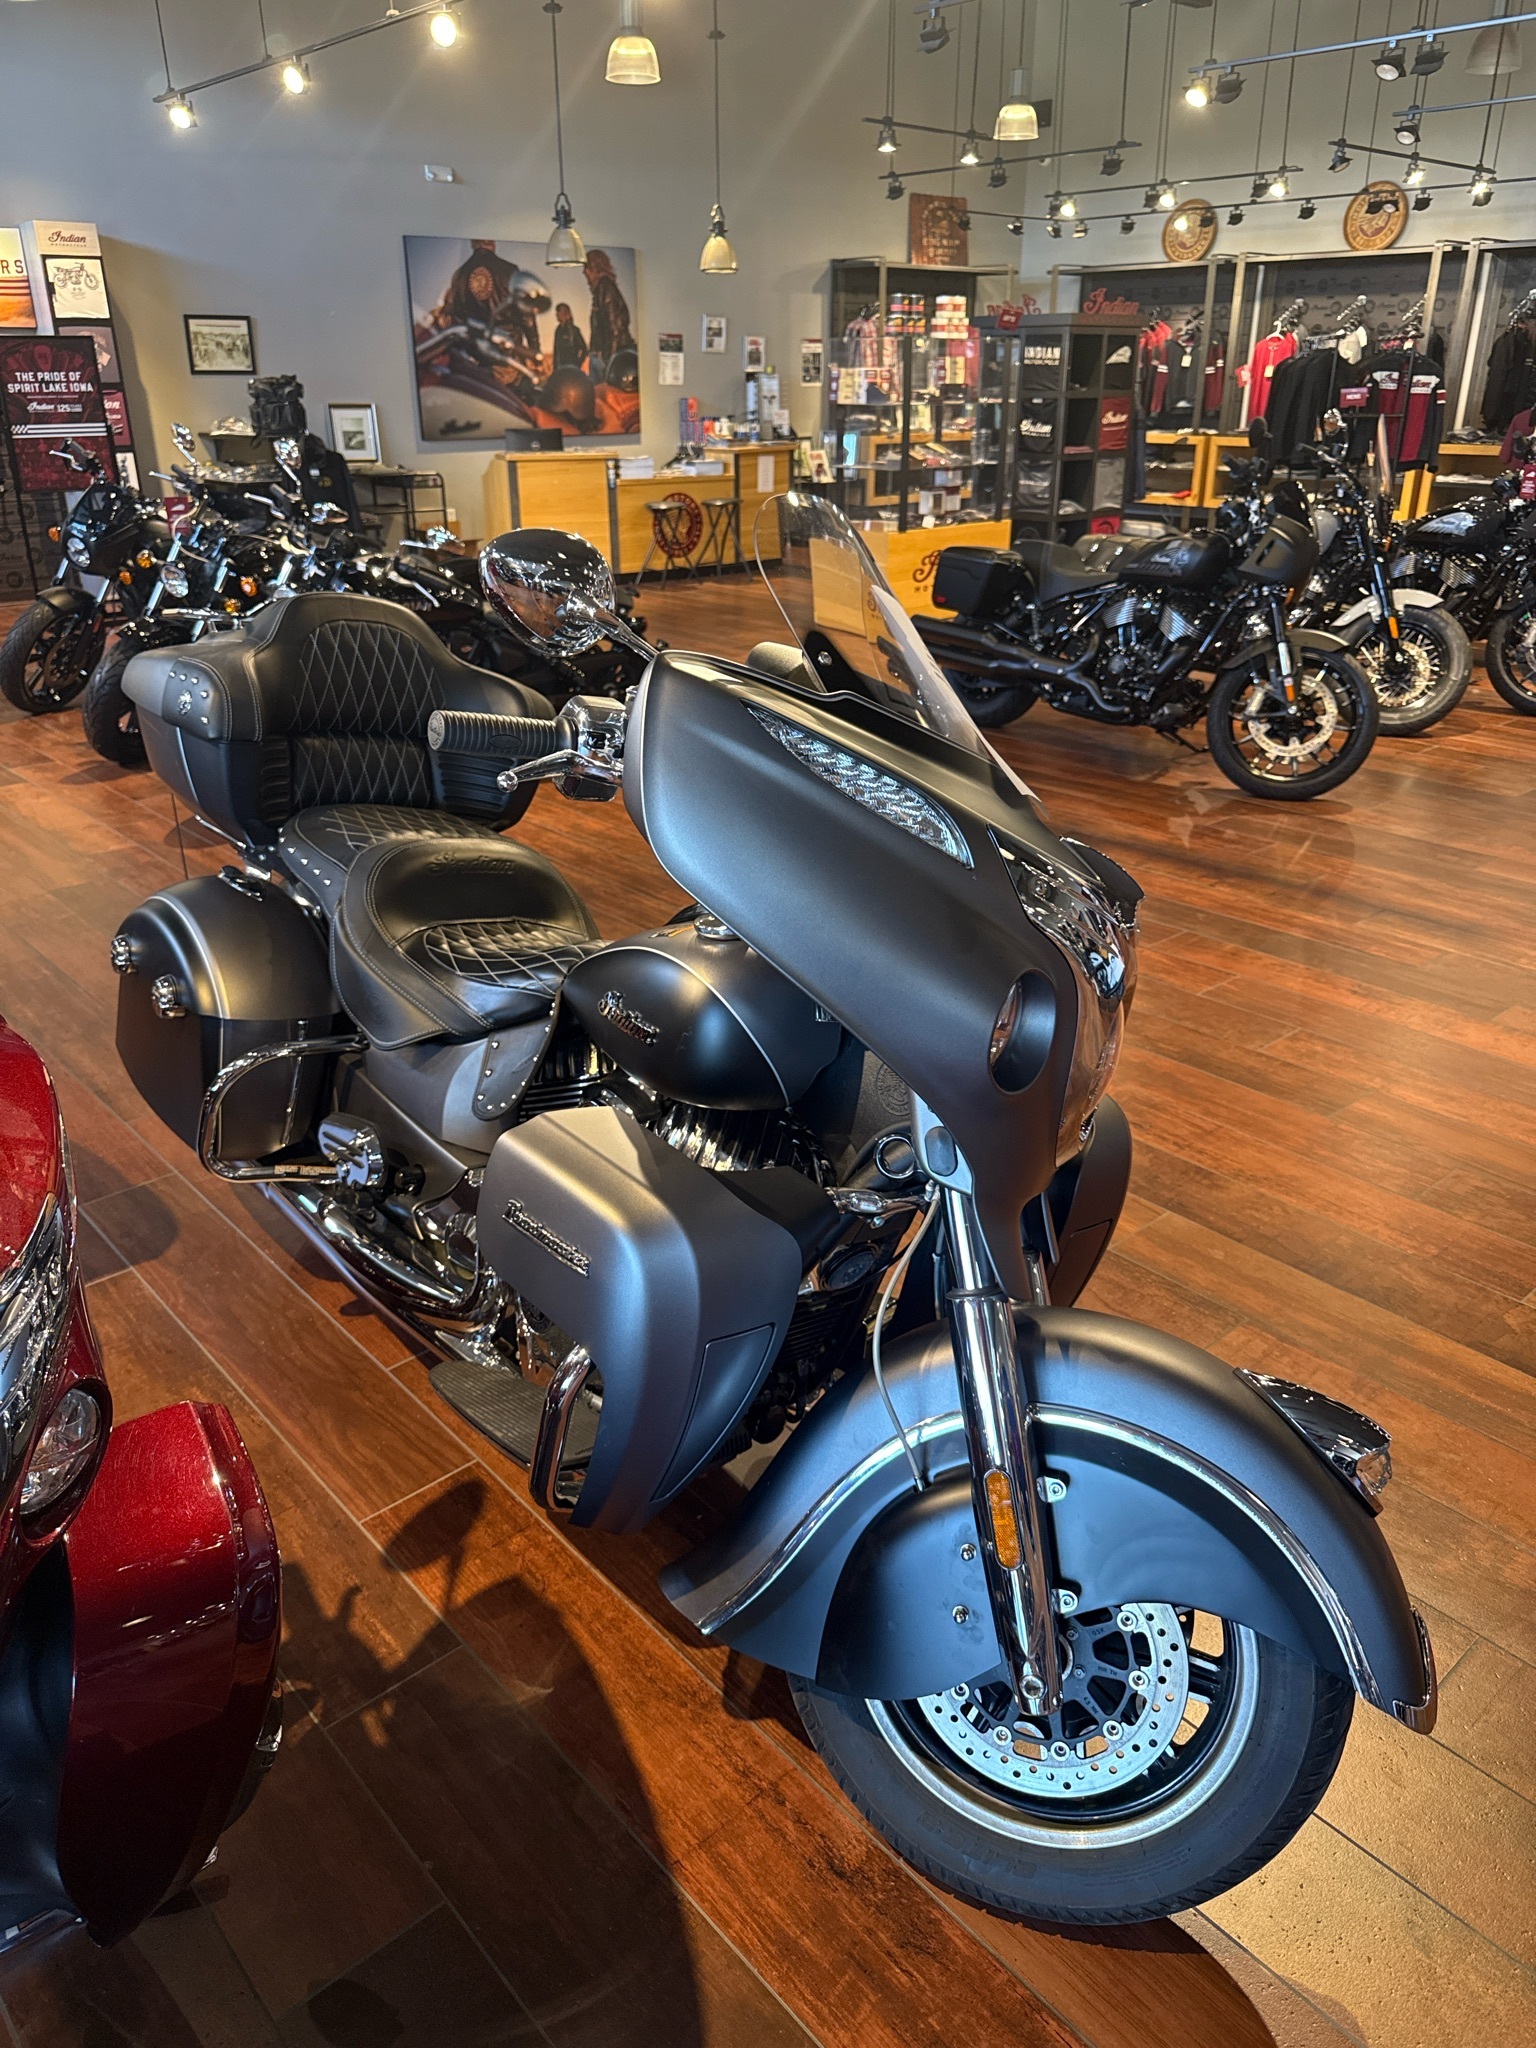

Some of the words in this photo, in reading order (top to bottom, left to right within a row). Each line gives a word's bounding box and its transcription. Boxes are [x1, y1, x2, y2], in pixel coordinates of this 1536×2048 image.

[48, 230, 87, 243] Indian
[1083, 288, 1139, 314] Indian
[1024, 346, 1061, 359] INDIAN
[15, 372, 36, 382] THE
[37, 372, 67, 382] PRIDE
[68, 372, 81, 382] OF
[7, 383, 40, 393] SPIRIT
[42, 383, 68, 393] LAKE
[70, 382, 94, 393] IOWA
[27, 402, 55, 410] Indian
[57, 404, 71, 412] 125
[1020, 418, 1052, 433] Indian
[597, 990, 660, 1045] Indian
